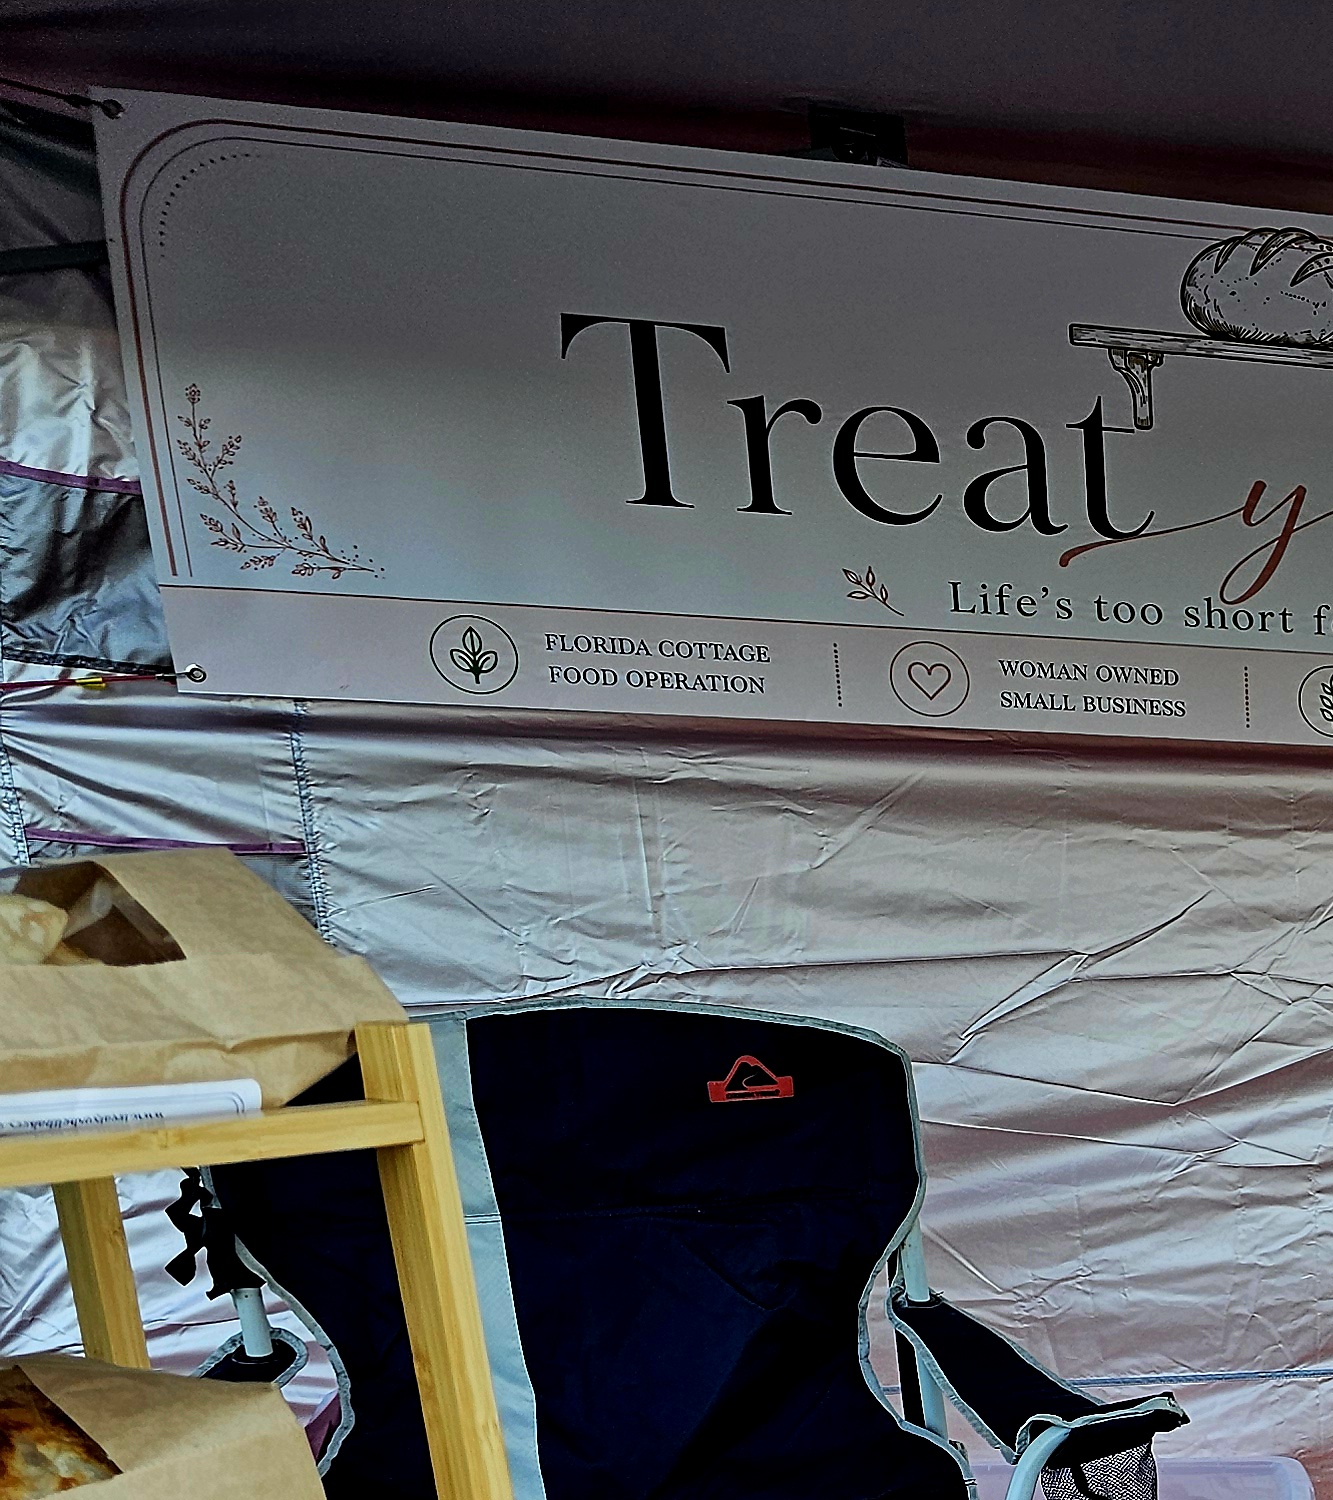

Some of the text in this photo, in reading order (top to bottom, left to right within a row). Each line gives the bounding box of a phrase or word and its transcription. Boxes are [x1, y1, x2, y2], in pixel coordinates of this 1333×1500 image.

[560, 312, 1156, 542] Treat
[1094, 594, 1164, 626] too
[1184, 596, 1295, 634] short
[545, 633, 771, 664] FLORIDA COTTAGE
[549, 665, 765, 694] FOOD OPERATION
[999, 659, 1179, 687] WOMAN OWNED
[1000, 690, 1186, 718] SMALL BUSINESS
